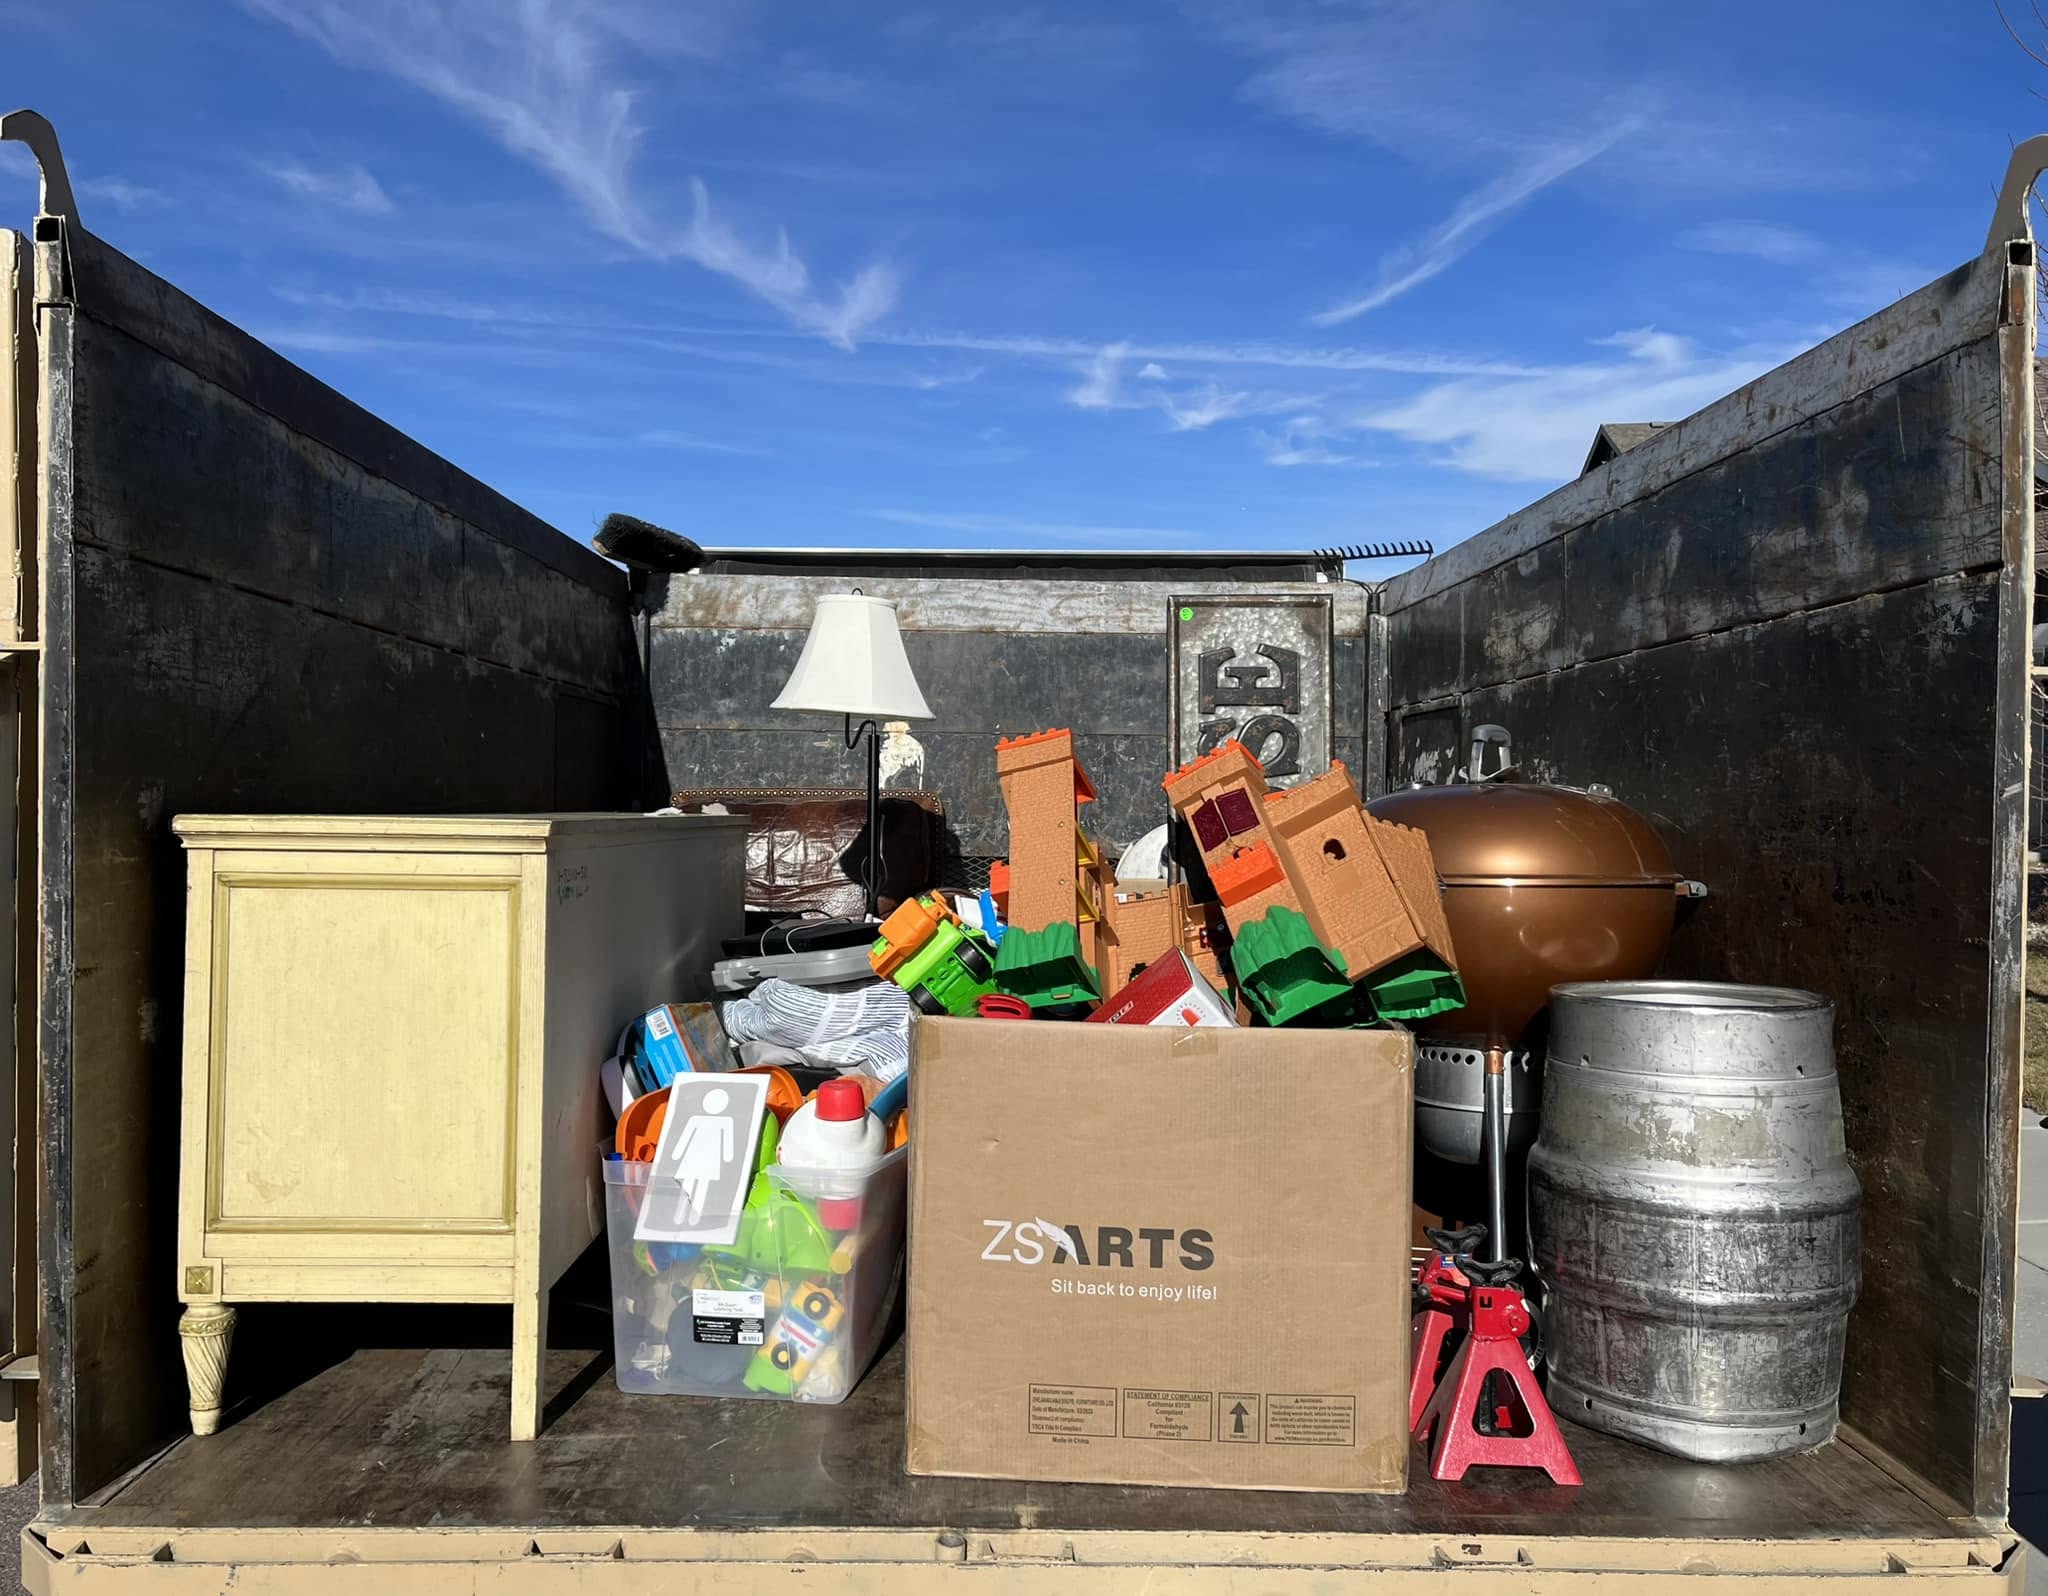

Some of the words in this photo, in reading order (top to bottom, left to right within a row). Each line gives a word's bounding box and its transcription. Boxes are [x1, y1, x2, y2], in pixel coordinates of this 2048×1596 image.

[980, 1218, 1215, 1271] ZSARTS
[1051, 1278, 1073, 1294] Sit
[1077, 1280, 1115, 1296] back
[1119, 1283, 1135, 1297] to
[1139, 1285, 1183, 1302] enjoy
[1187, 1286, 1217, 1301] life!
